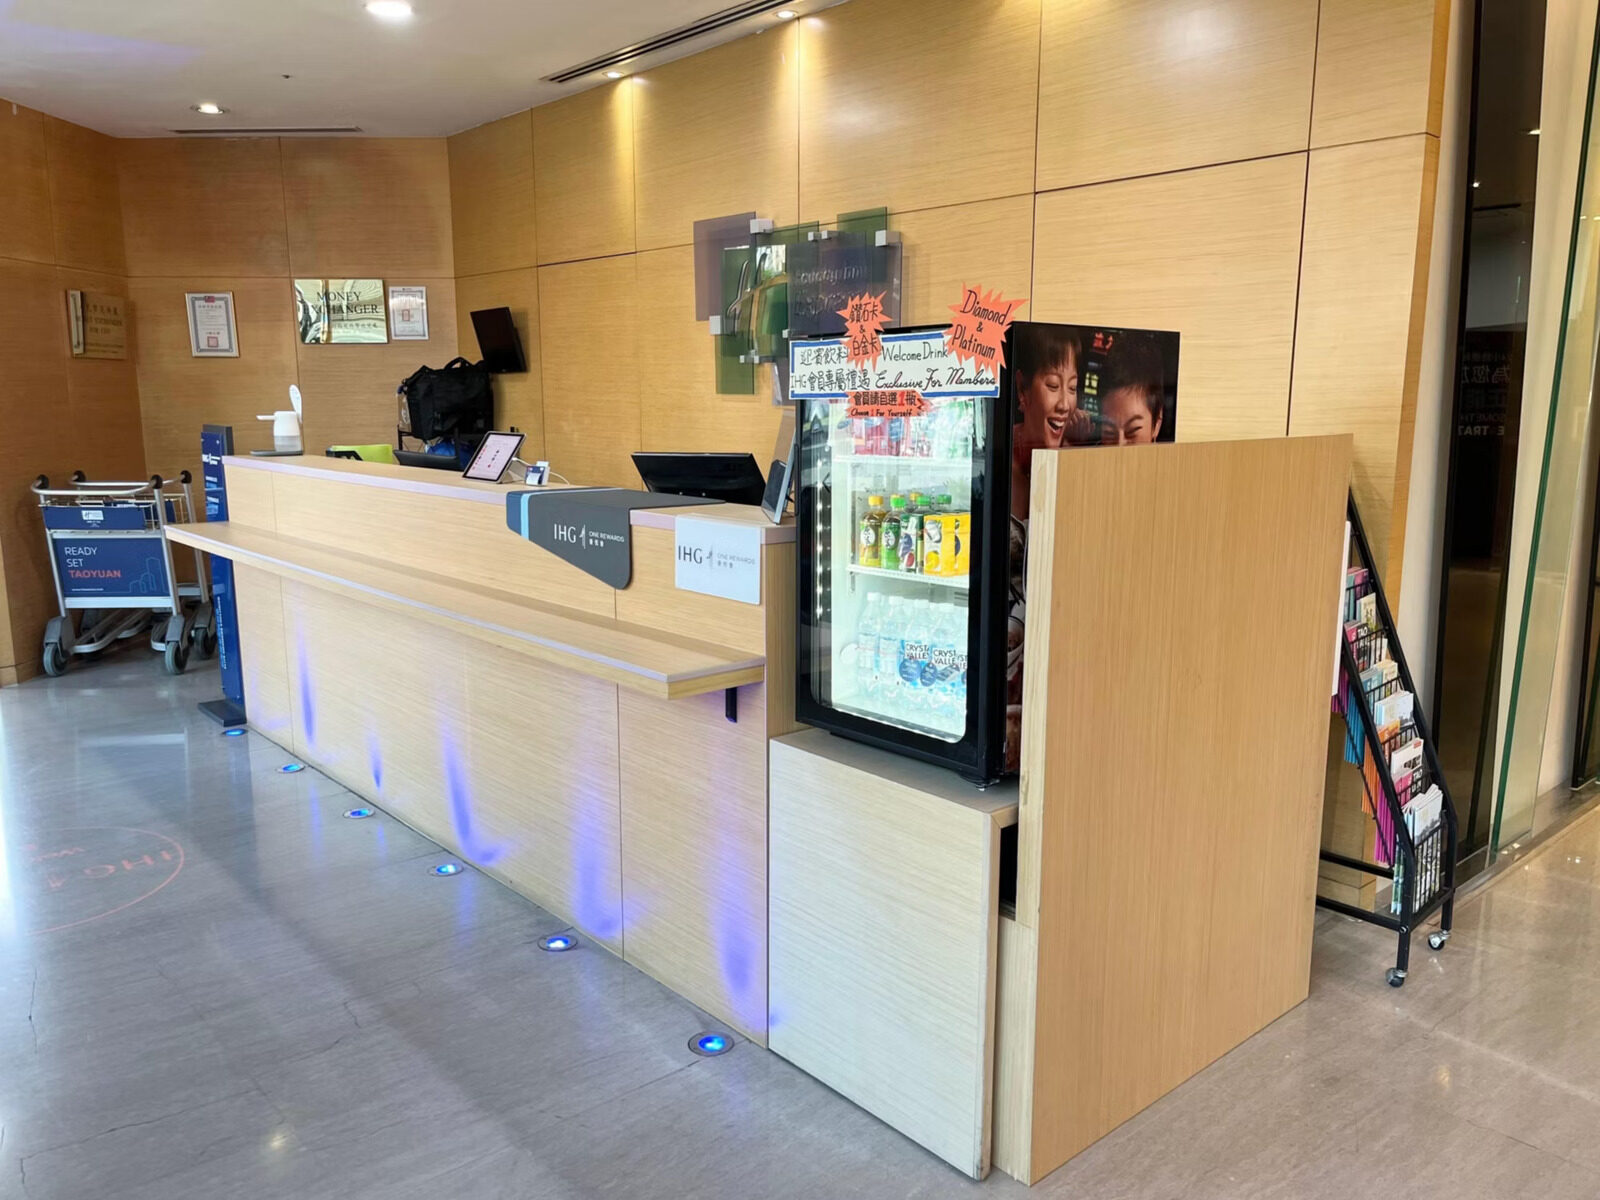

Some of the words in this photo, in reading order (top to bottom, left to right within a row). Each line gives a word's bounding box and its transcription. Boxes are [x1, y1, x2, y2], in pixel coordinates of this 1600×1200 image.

[316, 291, 362, 302] MONEY
[849, 301, 878, 323] 鑽石卡
[960, 289, 1012, 326] Diamond
[859, 324, 866, 334] &
[976, 321, 984, 333] &
[852, 333, 879, 357] 白金卡
[881, 344, 921, 362] Welcome
[923, 340, 949, 360] Drink
[951, 324, 996, 359] Platinum
[875, 369, 923, 389] Exclusive
[922, 367, 943, 391] For
[888, 408, 913, 417] Yourself
[553, 522, 577, 544] IHG
[588, 530, 600, 539] ONE
[599, 531, 625, 543] REWARDS
[64, 546, 98, 556] READY
[677, 544, 703, 564] IHG
[66, 558, 85, 568] SET
[68, 569, 121, 579] TAOYUAN
